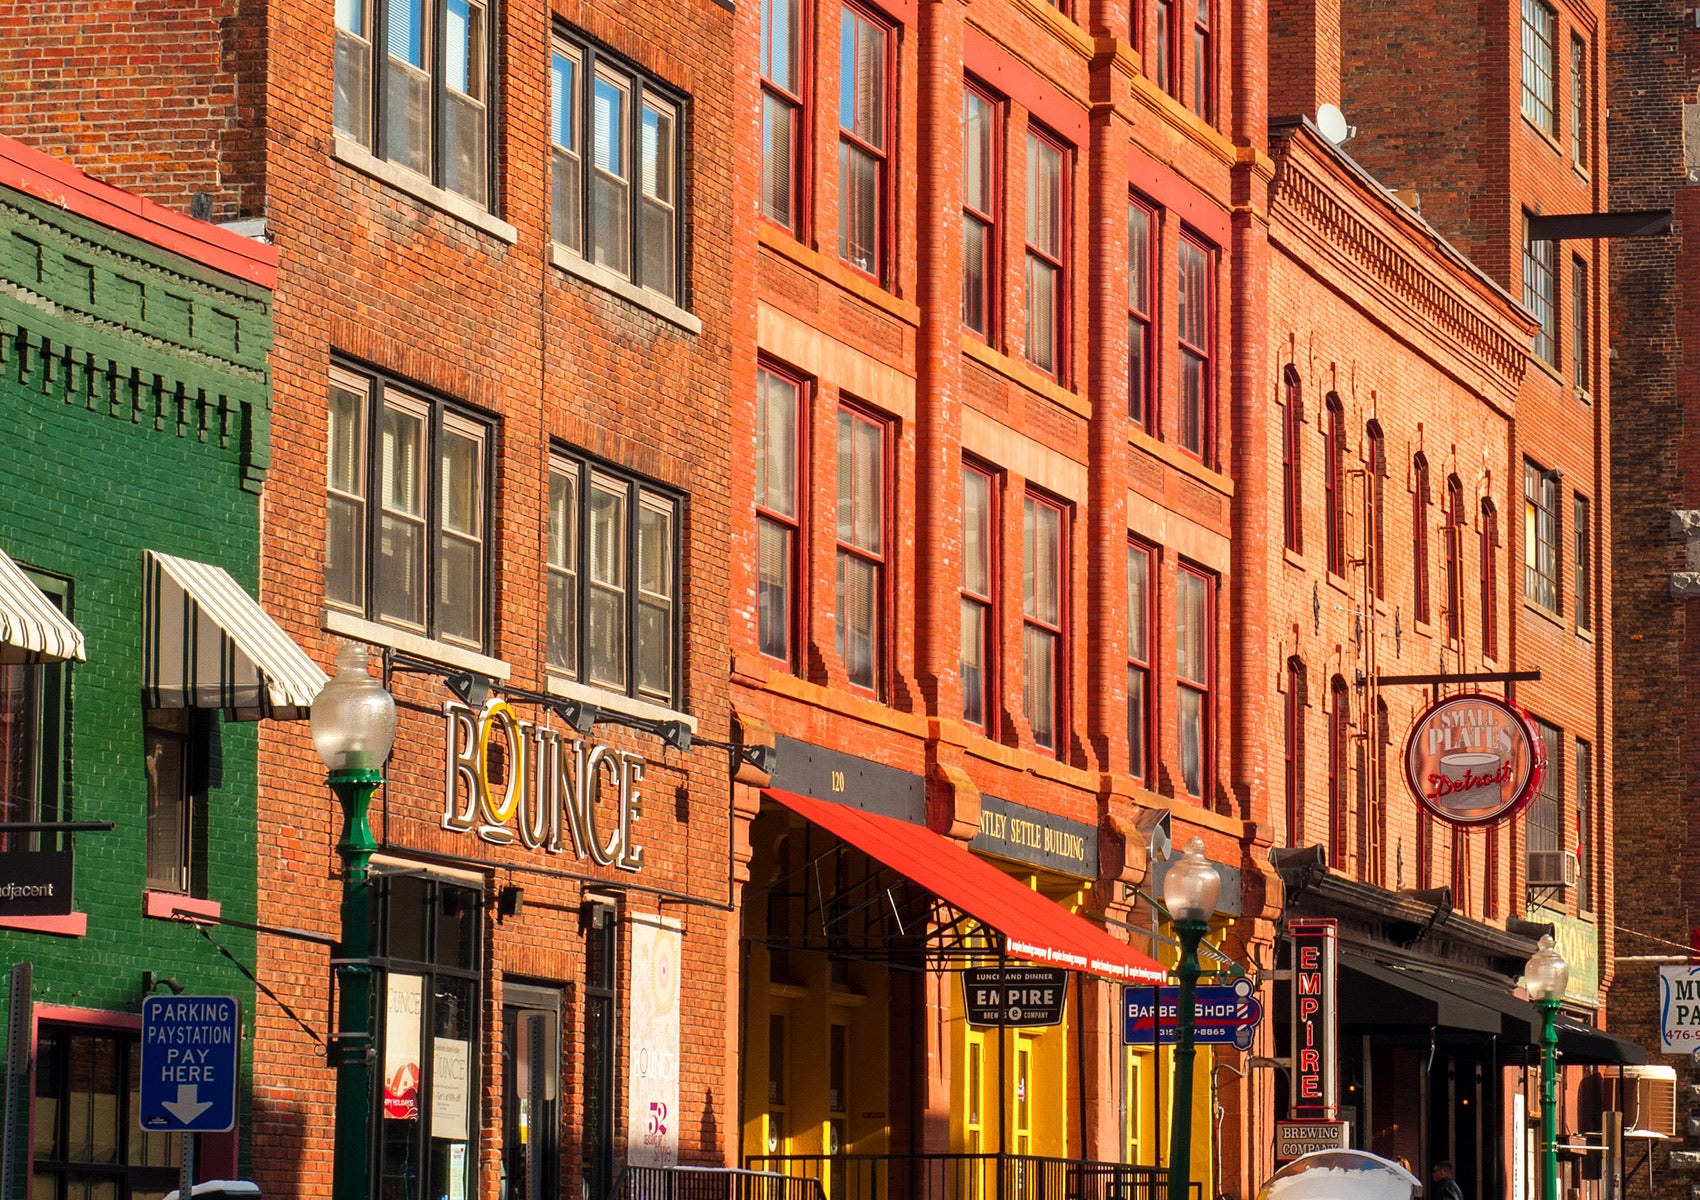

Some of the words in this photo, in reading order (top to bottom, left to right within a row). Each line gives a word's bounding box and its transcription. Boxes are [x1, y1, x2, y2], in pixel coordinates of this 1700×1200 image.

[1441, 709, 1498, 728] SMALL
[1428, 725, 1512, 756] PLATES
[441, 698, 646, 871] BOUNCE
[831, 770, 845, 792] 120
[1427, 760, 1513, 799] Detroit
[1010, 818, 1042, 849] SETTLE
[1043, 826, 1084, 862] BUILDING
[0, 882, 53, 900] djacent
[976, 990, 1054, 1005] EMPIRE
[151, 1003, 229, 1021] PARKING
[983, 1011, 1008, 1019] BREWG
[1023, 1011, 1049, 1019] COMPANY
[1128, 1004, 1179, 1018] BARBE
[1194, 1003, 1235, 1017] SHOP
[1298, 946, 1323, 1098] EMPIRE
[148, 1026, 231, 1044] PAYSTATION
[167, 1048, 210, 1064] PAY
[161, 1066, 215, 1082] HERE
[648, 1102, 668, 1136] 52
[1283, 1127, 1339, 1139] BREWING
